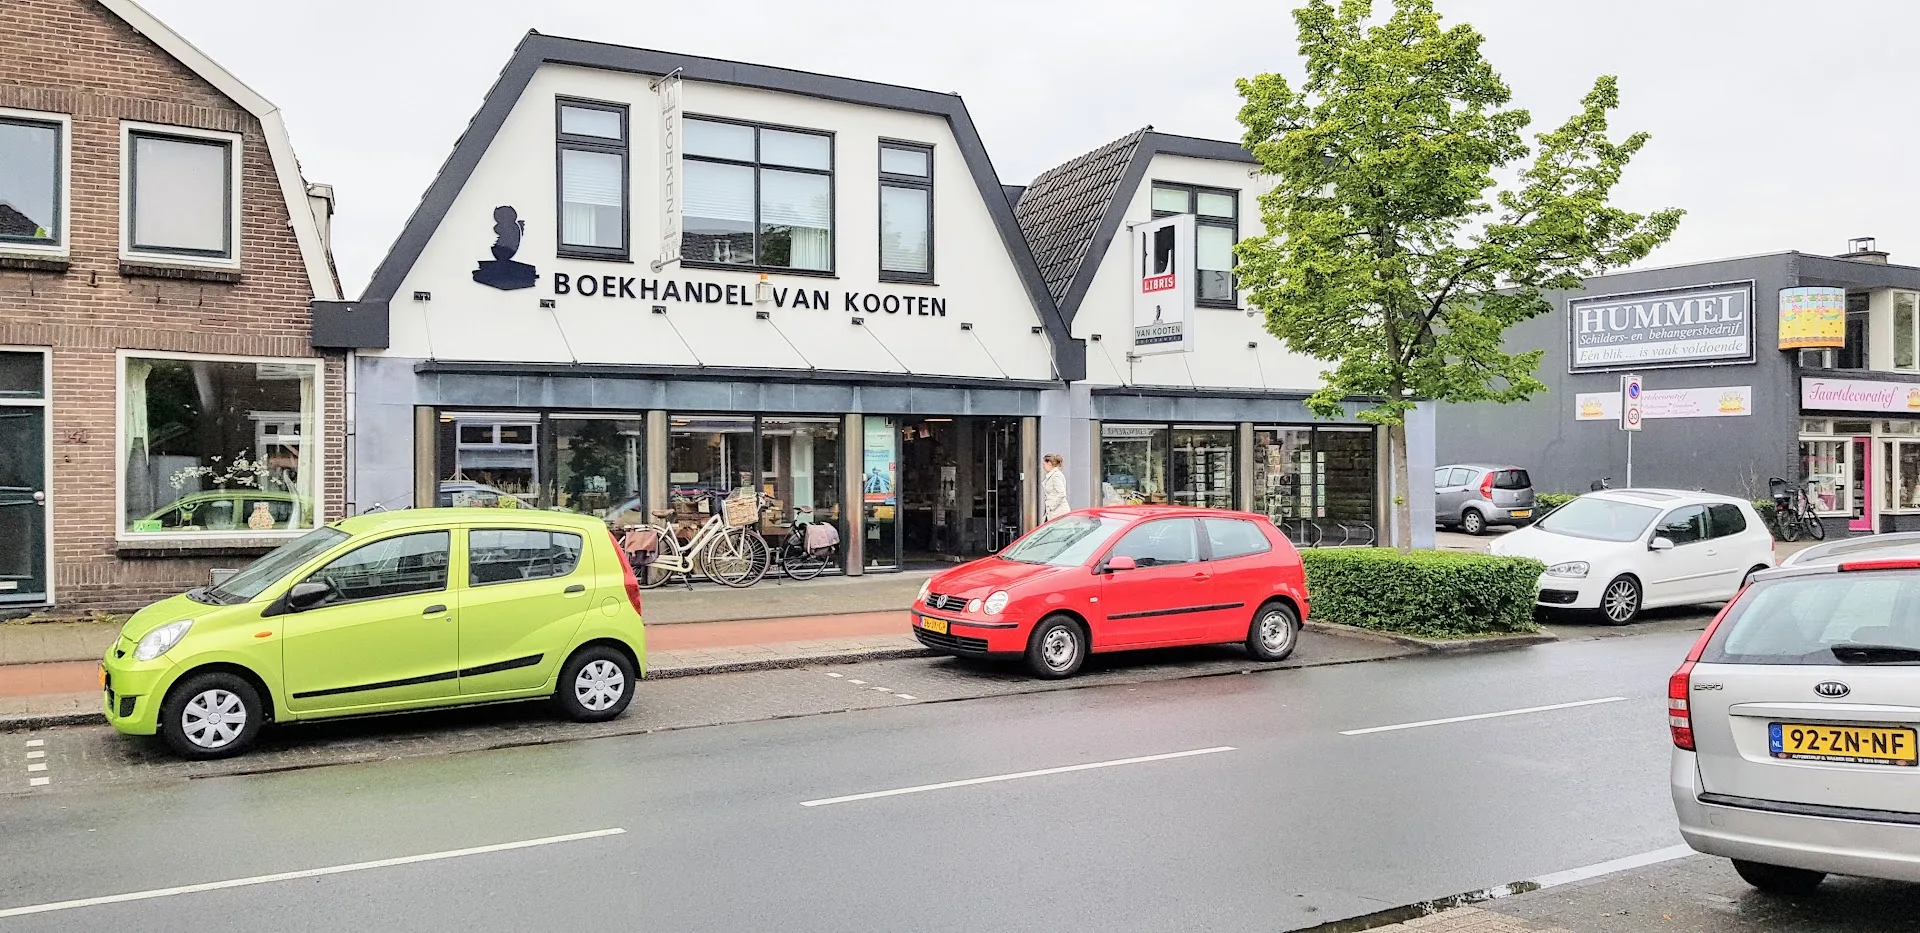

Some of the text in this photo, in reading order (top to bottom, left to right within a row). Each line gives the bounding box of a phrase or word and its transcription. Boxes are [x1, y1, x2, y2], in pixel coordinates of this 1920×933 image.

[554, 272, 946, 317] BOEKHANDEL VAN KOOTEN
[1144, 277, 1173, 291] LIBRIS
[1579, 296, 1743, 334] HUMMEL
[1136, 325, 1181, 338] VAN KOOTEN
[1580, 322, 1743, 345] Schilders- en behangersbedrijf
[1603, 348, 1622, 360] blik
[1639, 346, 1648, 357] is
[1652, 344, 1679, 356] vaak
[1682, 339, 1743, 354] voldoende
[1809, 383, 1899, 408] Taartdecoratief
[1819, 682, 1845, 695] KIA
[1772, 740, 1782, 748] NL
[1790, 729, 1905, 755] 92-ZN-NF
